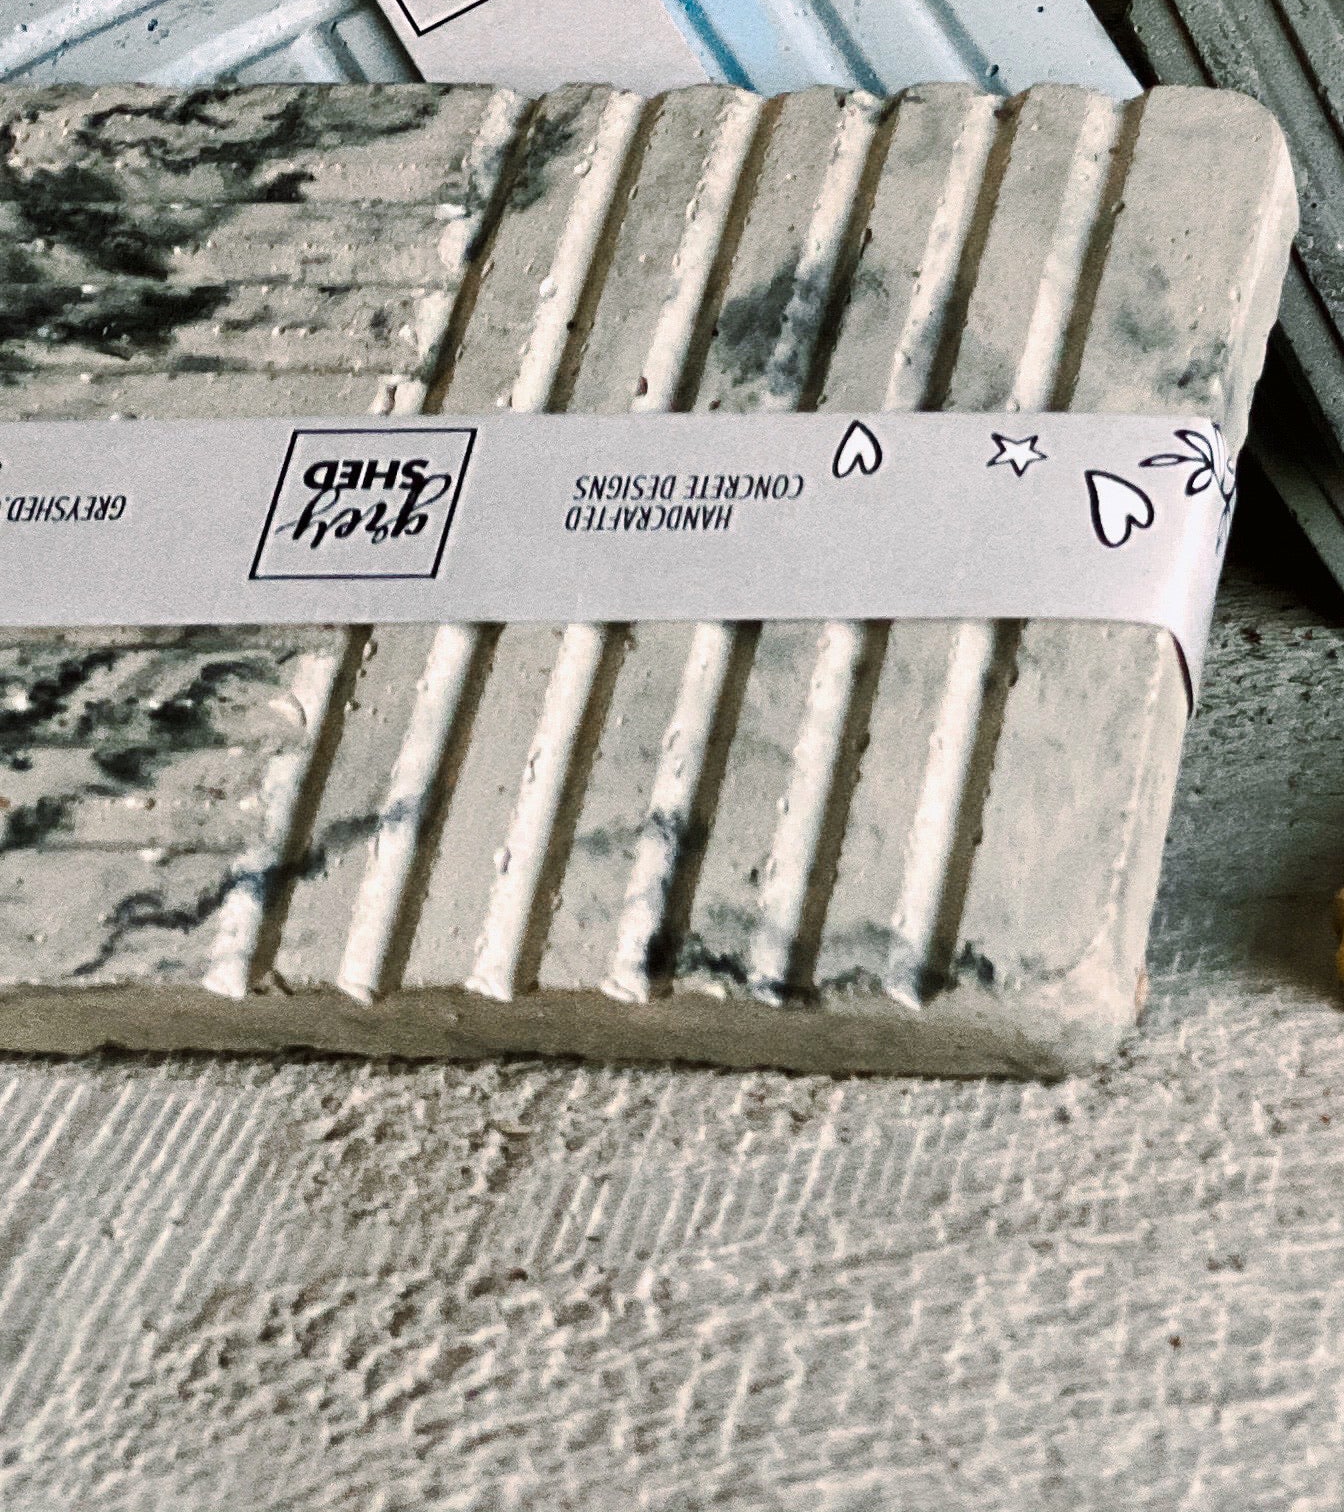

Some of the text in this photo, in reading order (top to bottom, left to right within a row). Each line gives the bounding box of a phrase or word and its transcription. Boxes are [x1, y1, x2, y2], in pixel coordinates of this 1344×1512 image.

[303, 459, 430, 490] SHED
[573, 474, 805, 500] CONCRETE DESIGNS
[275, 474, 452, 549] grey
[565, 505, 734, 531] HANDCRAFTED
